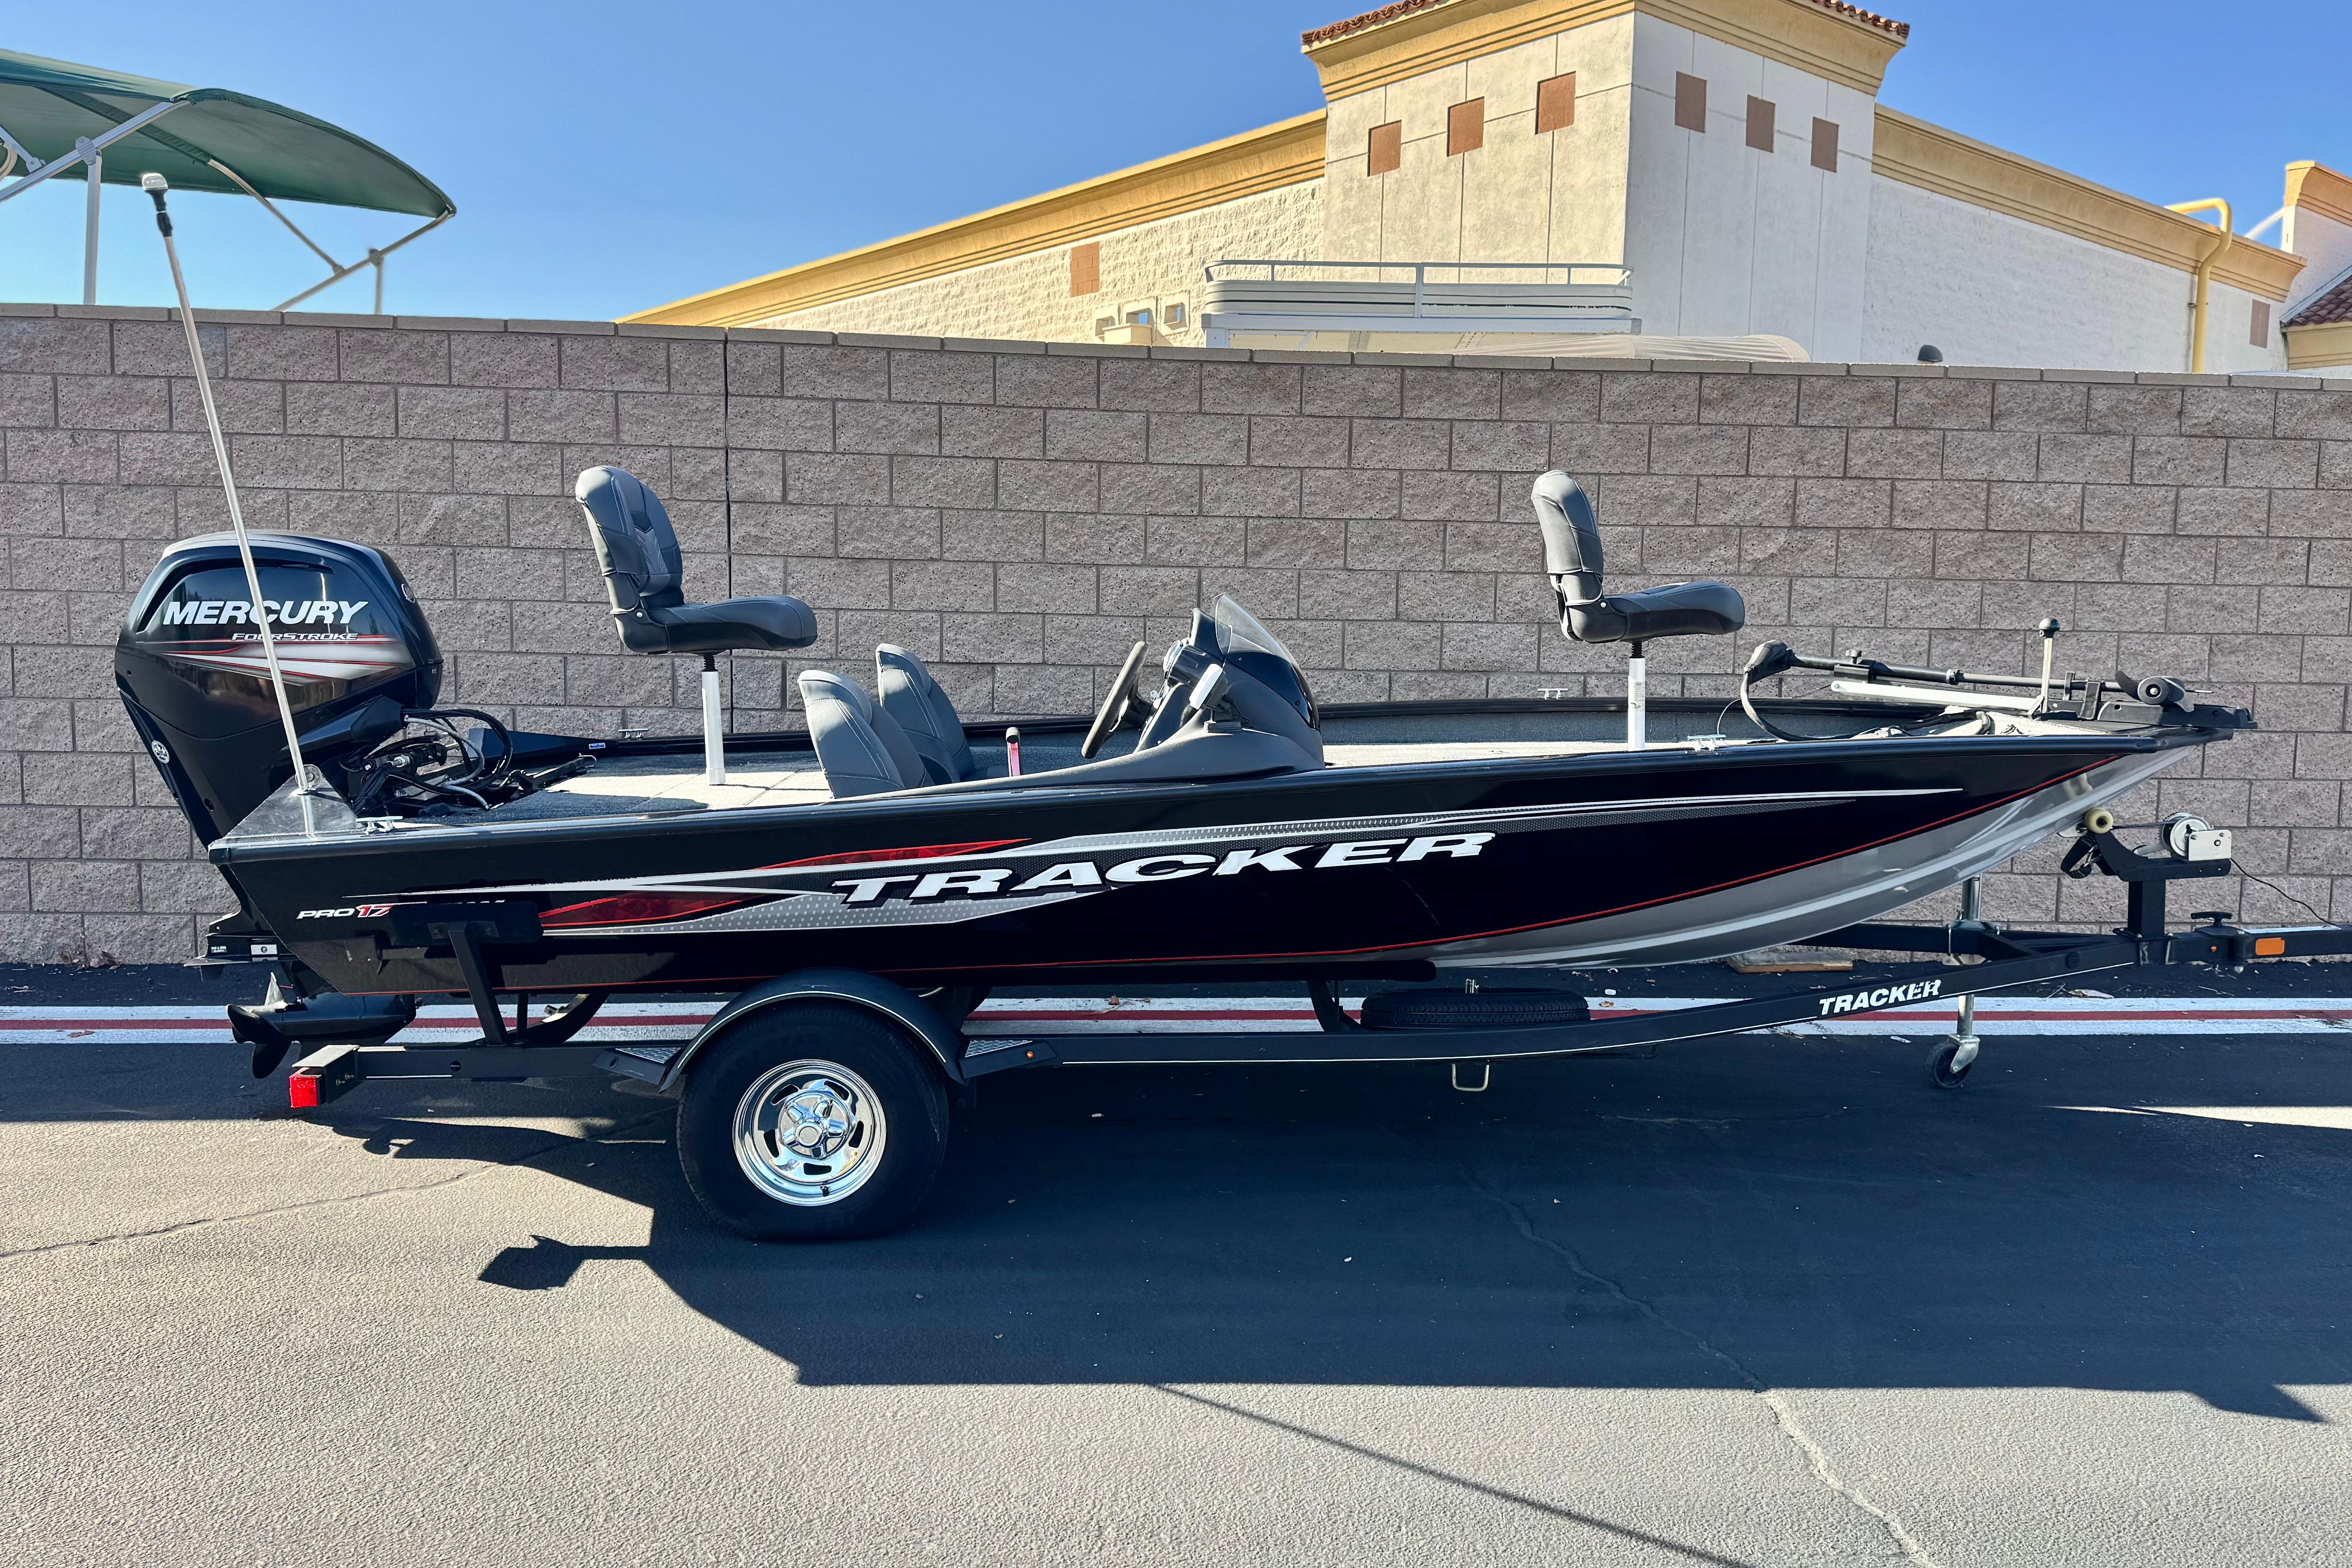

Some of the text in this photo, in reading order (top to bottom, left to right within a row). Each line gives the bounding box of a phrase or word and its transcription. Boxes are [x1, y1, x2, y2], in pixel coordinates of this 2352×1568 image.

[163, 600, 368, 625] MERCURY
[831, 832, 1496, 903] TRACKER
[1819, 979, 1942, 1016] TRACKER
